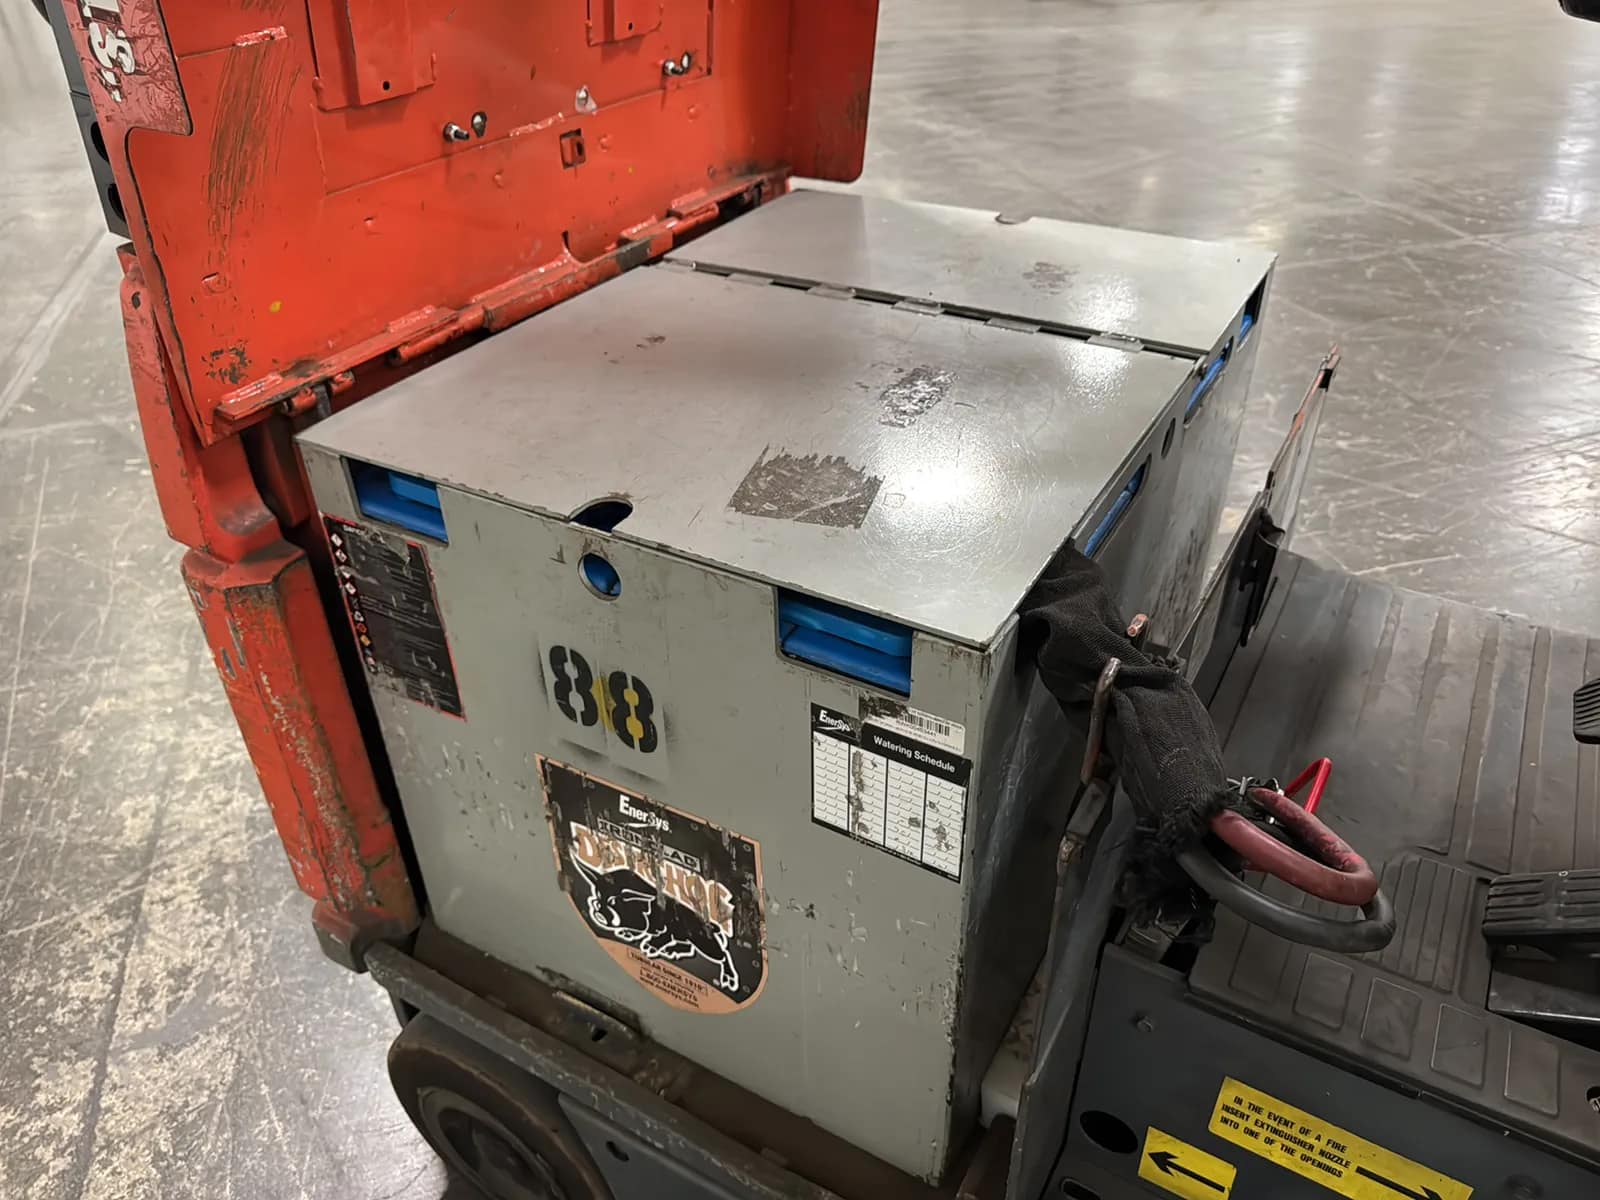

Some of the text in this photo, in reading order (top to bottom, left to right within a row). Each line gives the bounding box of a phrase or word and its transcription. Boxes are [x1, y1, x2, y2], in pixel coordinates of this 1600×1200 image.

[549, 645, 658, 753] 88
[819, 709, 851, 732] EnerSys
[873, 735, 956, 773] Watering Schedule
[619, 795, 671, 831] EnerSys
[1220, 1116, 1344, 1178] INTO ONE OF THE OPENINGS
[1222, 1103, 1352, 1169] INSERT EXTINGUISHER NOZZLE
[1233, 1095, 1348, 1153] IN THE EVENT OF A FIRE
